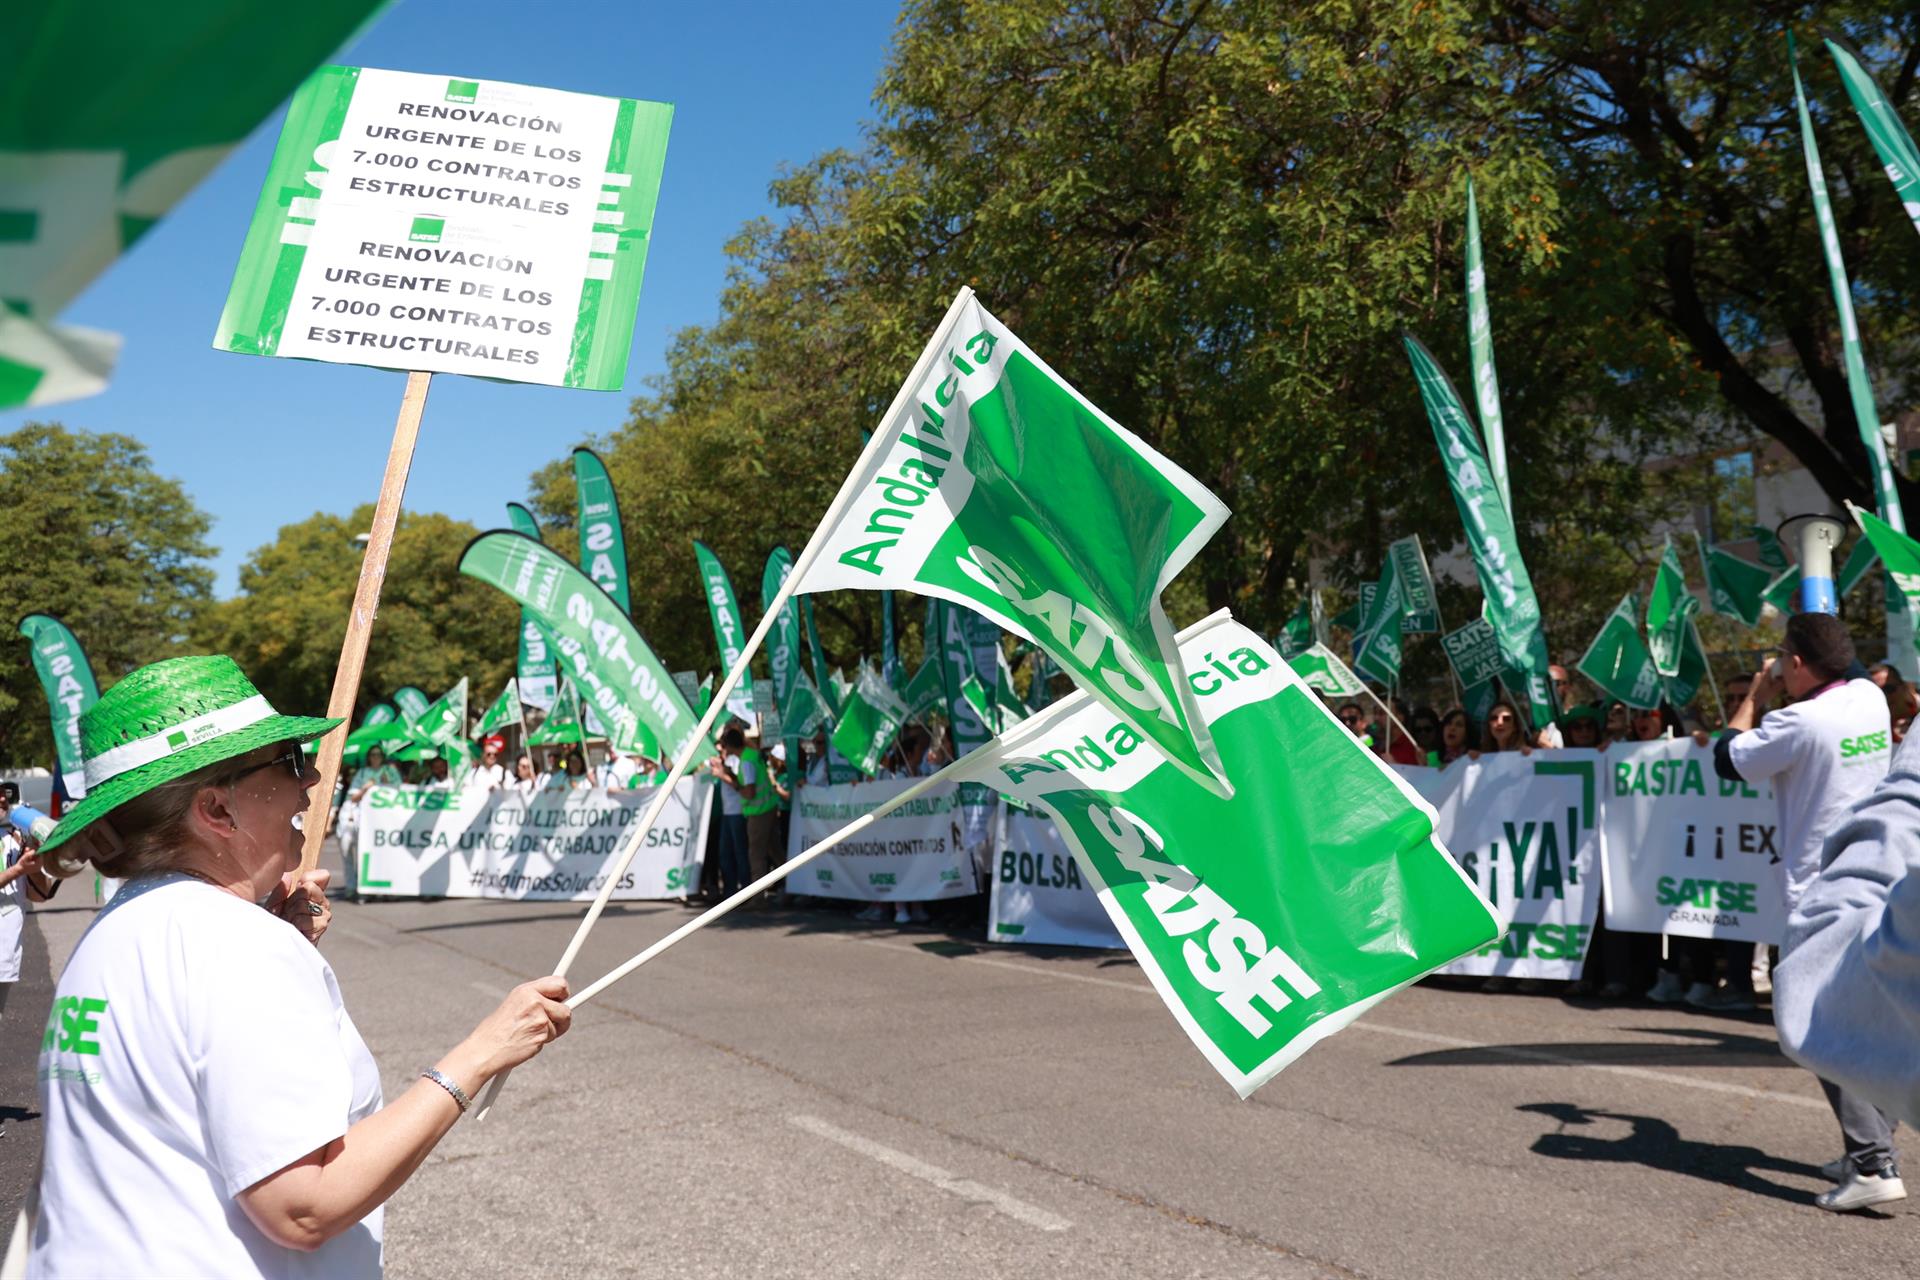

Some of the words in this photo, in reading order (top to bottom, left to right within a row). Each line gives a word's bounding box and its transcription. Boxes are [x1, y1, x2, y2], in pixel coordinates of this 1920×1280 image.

[398, 102, 563, 134] RENOVACIÓN
[365, 125, 486, 149] URGENTE
[493, 139, 526, 155] DE
[534, 145, 582, 163] LOS
[352, 150, 419, 169] 7.000
[427, 158, 582, 190] CONTRATOS
[349, 177, 570, 216] ESTRUCTURALES
[359, 241, 533, 275] RENOVACIÓN
[324, 267, 451, 293] URGENTE
[459, 281, 495, 299] DE
[502, 287, 553, 306] LOS
[311, 296, 381, 316] 7.000
[389, 305, 553, 336] CONTRATOS
[307, 326, 540, 365] ESTRUCTURALES
[1474, 655, 1501, 680] JAE
[1000, 647, 1269, 784] Andacía
[1840, 730, 1888, 758] SATSE
[1615, 759, 1705, 797] BASTA
[370, 788, 461, 811] SATSE
[374, 828, 449, 849] BOLSA
[646, 826, 685, 848] SAS
[1000, 851, 1082, 890] BOLSA
[1655, 875, 1758, 914] SATSE
[1087, 804, 1322, 1040] SATSE
[1668, 910, 1740, 928] GRANADA
[1476, 922, 1591, 962] ATSE
